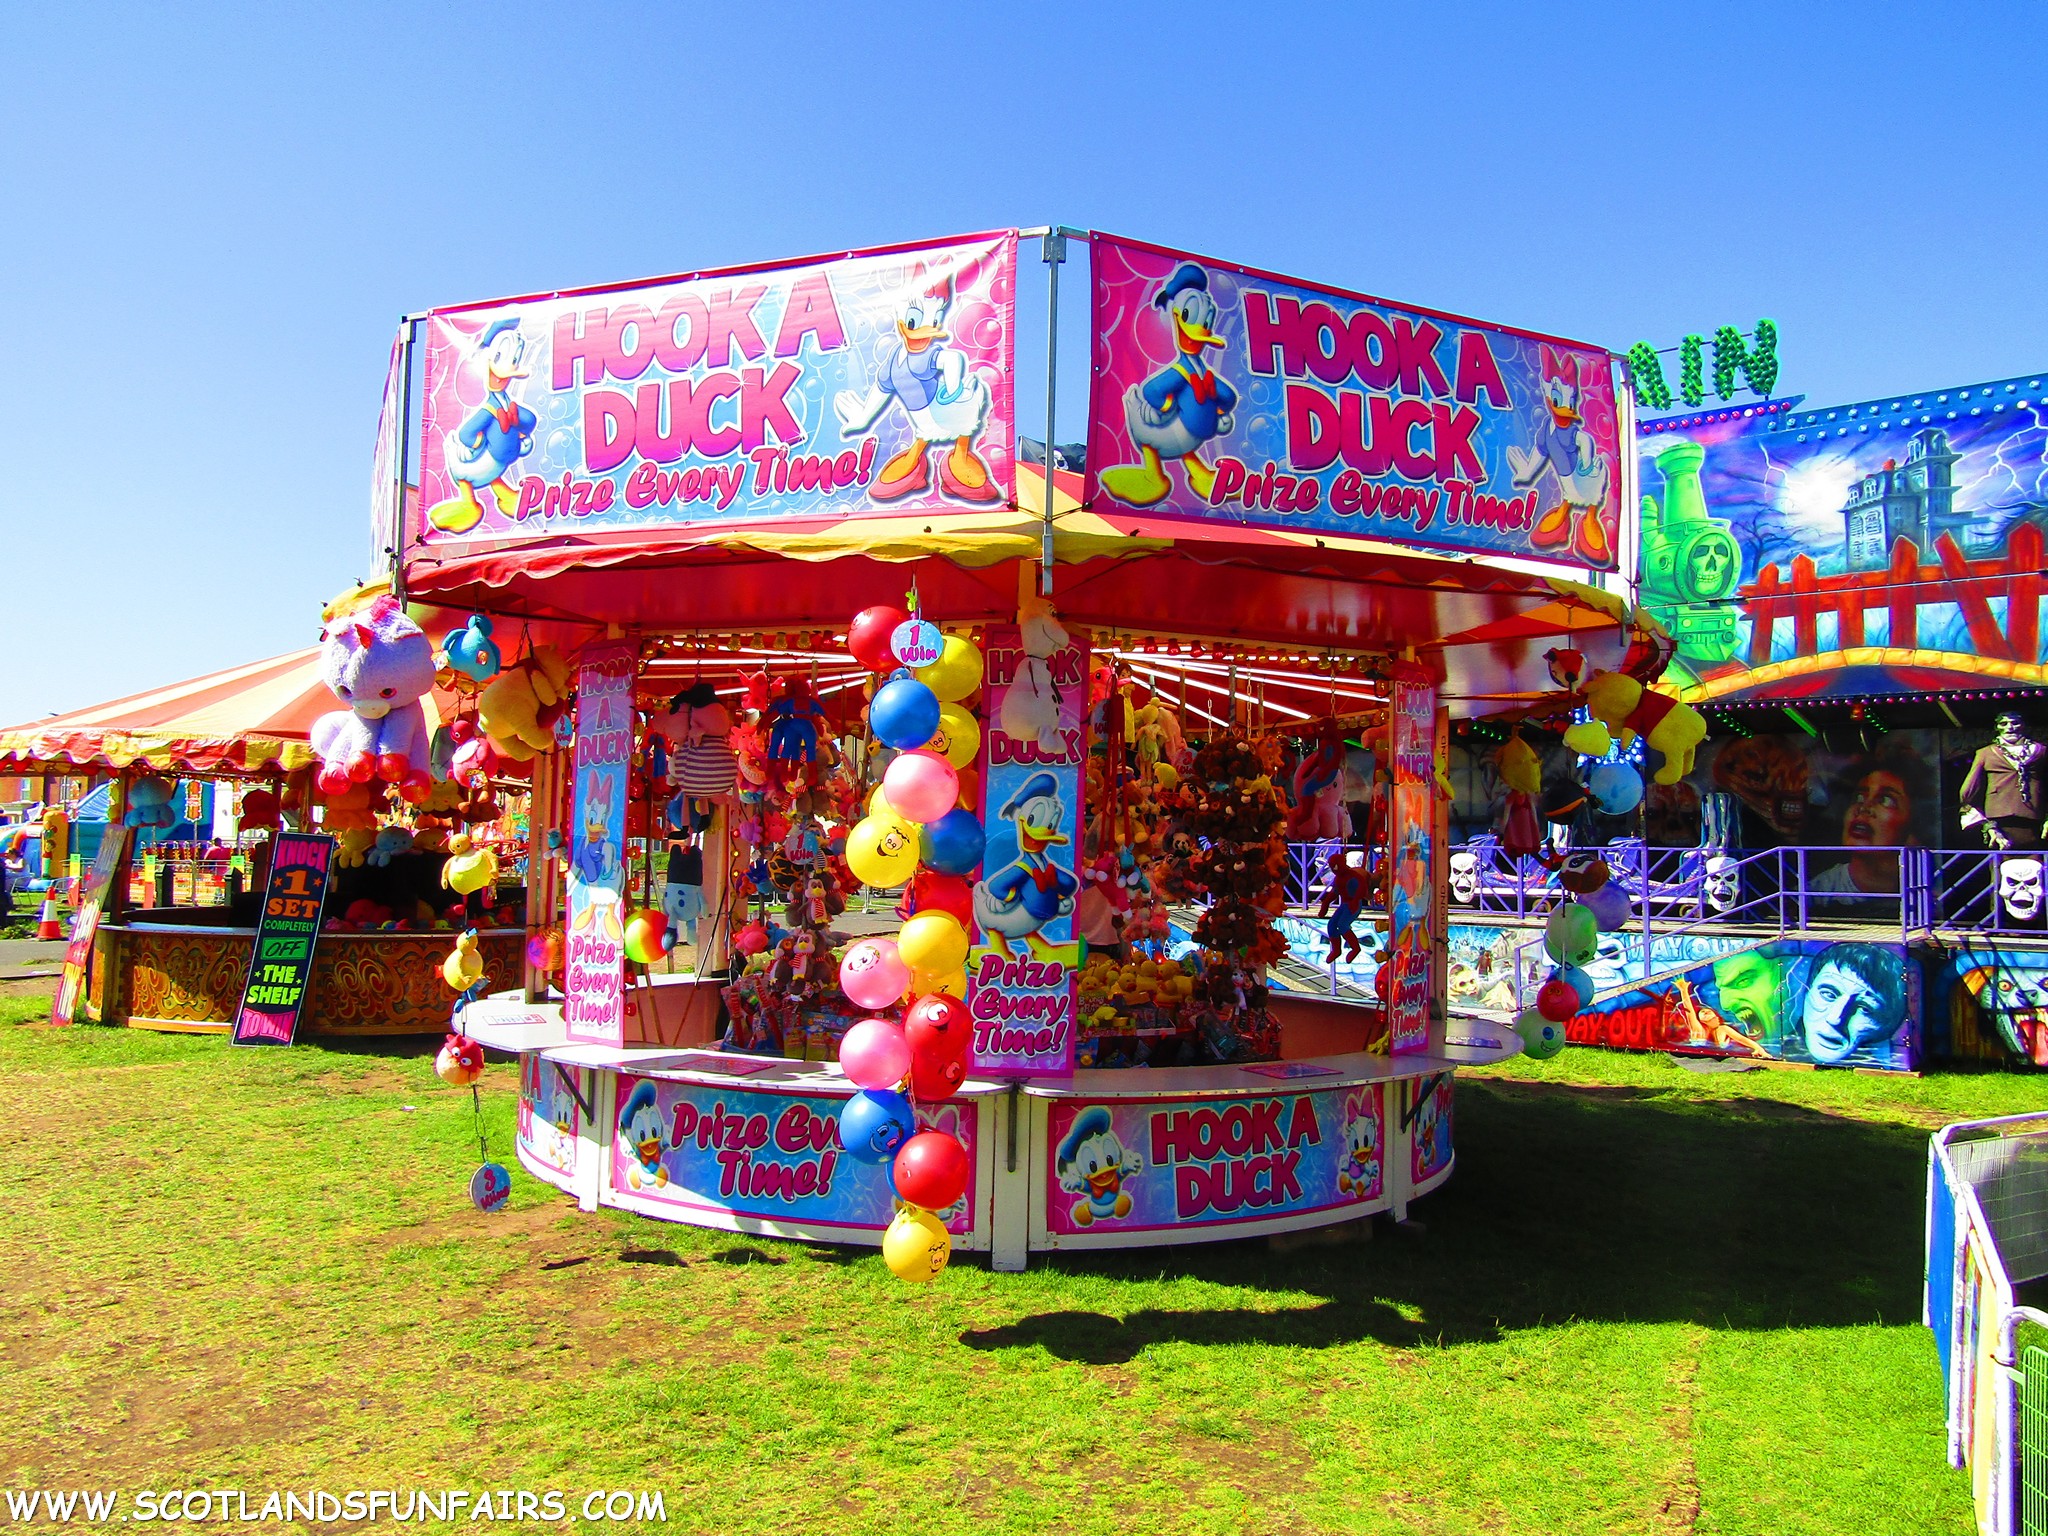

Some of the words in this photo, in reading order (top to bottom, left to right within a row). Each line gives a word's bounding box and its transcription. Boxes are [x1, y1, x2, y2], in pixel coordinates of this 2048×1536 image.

[551, 283, 767, 391] HOOK
[774, 271, 845, 357] A
[1243, 291, 1447, 399] HOOK
[1455, 331, 1512, 409] A
[1629, 318, 1778, 410] AIN
[583, 363, 805, 472] DUCK
[1286, 385, 1488, 484] DUCK
[517, 476, 616, 522] Prize
[626, 459, 745, 511] Every
[753, 438, 878, 496] Time!
[1210, 457, 1320, 513] Prize
[1330, 468, 1439, 532] Every
[1443, 479, 1538, 533] Time!
[909, 624, 920, 647] 1
[900, 645, 937, 662] Win
[987, 647, 1082, 686] HK
[580, 655, 632, 697] HOOK
[595, 695, 613, 730] A
[1395, 680, 1432, 717] HOOK
[577, 727, 630, 769] DUCK
[987, 727, 1082, 767] DUK
[1408, 718, 1421, 751] A
[1397, 752, 1432, 787] DUCK
[274, 839, 330, 874] KNOCK
[790, 848, 814, 861] Win
[797, 832, 805, 849] 1
[282, 869, 311, 896] 1
[267, 897, 320, 918] SET
[263, 918, 316, 933] COMPLETELY
[265, 939, 305, 958] OFF
[571, 935, 616, 964] Prize
[1394, 947, 1427, 980] Prize
[262, 964, 298, 984] THE
[569, 964, 620, 1000] Every
[977, 953, 1064, 988] Prize
[246, 985, 302, 1006] SHELF
[569, 993, 619, 1027] Time!
[972, 986, 1070, 1027] Every
[1392, 978, 1428, 1011] Every
[239, 1008, 262, 1039] TO
[260, 1011, 295, 1042] WIN
[1392, 1000, 1428, 1040] Time!
[1609, 1007, 1659, 1044] OUT
[973, 1020, 1068, 1056] Time!
[671, 1102, 771, 1151] Prize
[1150, 1098, 1285, 1166] HOOK
[1286, 1095, 1322, 1149] A
[483, 1169, 497, 1192] 3
[717, 1148, 838, 1202] Time!
[1174, 1151, 1304, 1220] DUCK
